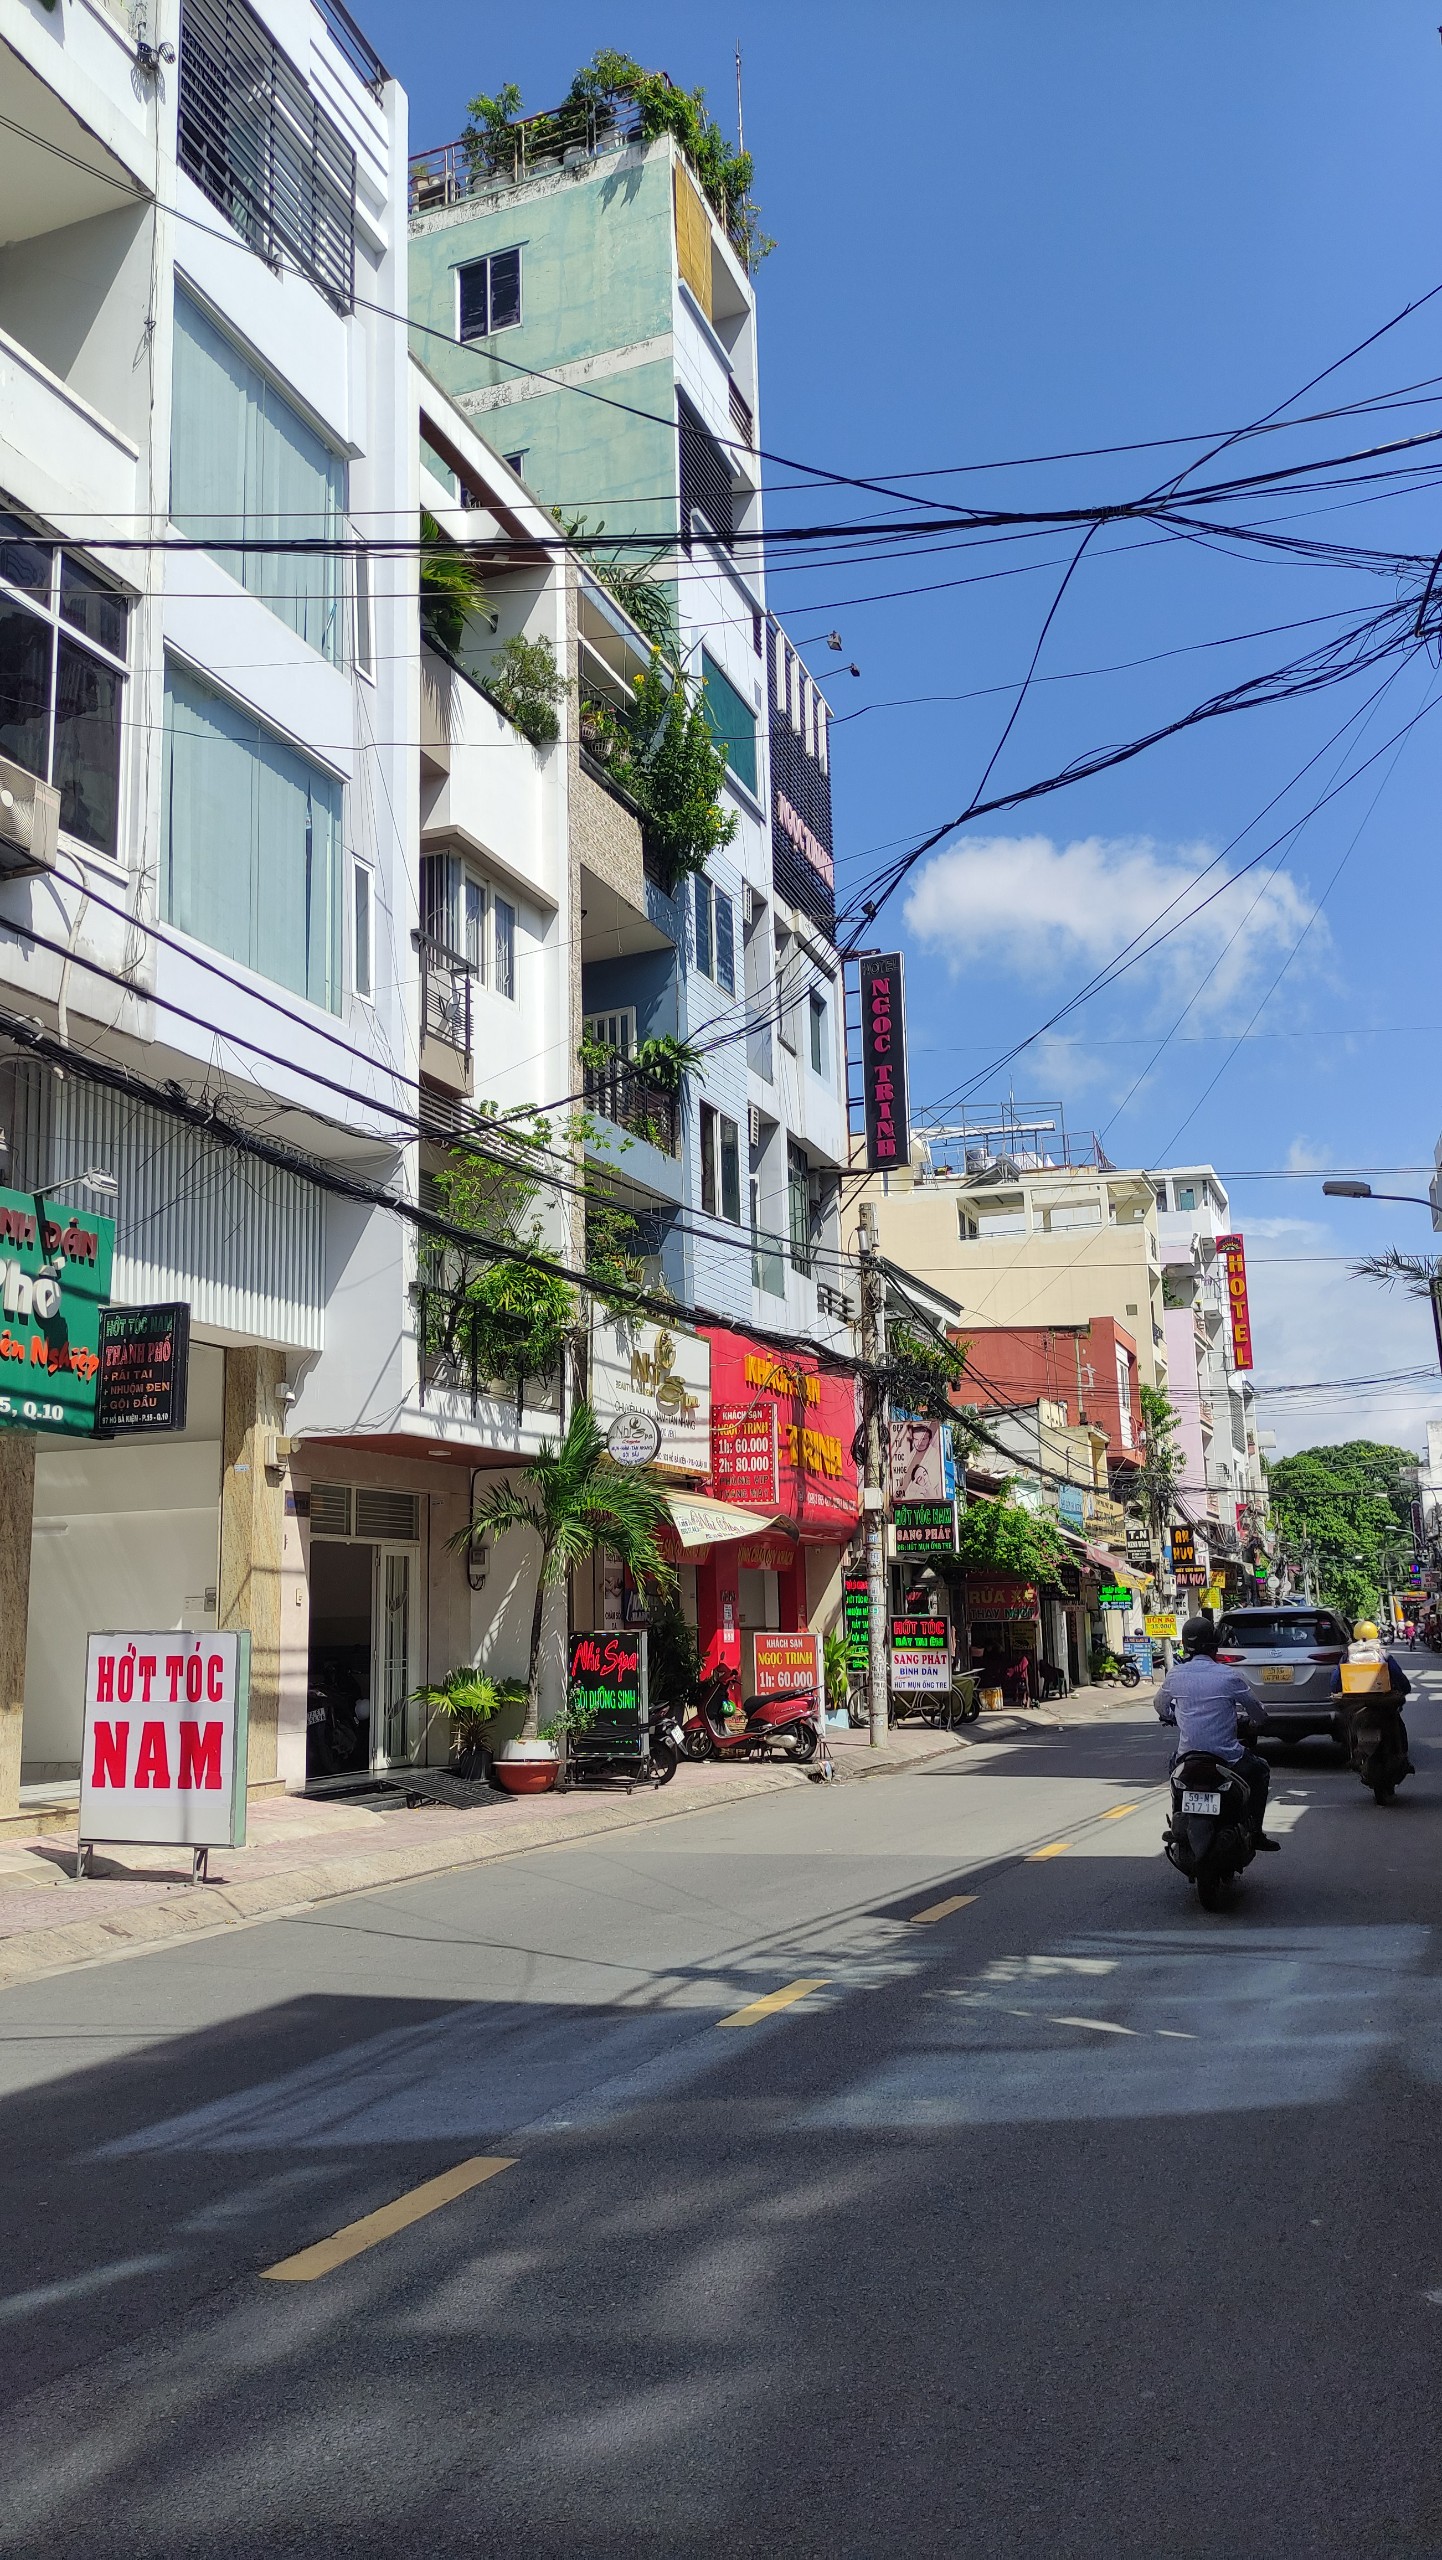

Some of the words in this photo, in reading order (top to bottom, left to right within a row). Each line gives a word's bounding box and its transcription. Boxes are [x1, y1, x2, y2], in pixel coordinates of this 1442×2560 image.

[862, 958, 899, 976] HOTEL
[1228, 1254, 1250, 1367] HOTEL
[148, 1333, 172, 1362] PHỐ
[133, 1369, 153, 1379] TAI
[110, 1383, 144, 1395] NHUỘM
[146, 1382, 170, 1392] ĐEN
[133, 1395, 157, 1408] ĐẦU
[23, 1401, 64, 1421] Q.10
[156, 1413, 168, 1421] Q.10
[722, 1410, 746, 1420] KHÁCH
[748, 1410, 762, 1420] SẠN
[742, 1422, 768, 1434] TRINH
[718, 1440, 732, 1454] 1h:
[736, 1437, 768, 1453] 60.000
[785, 1423, 843, 1477] TRINH
[718, 1458, 732, 1472] 2h:
[736, 1456, 768, 1472] 80.000
[754, 1475, 768, 1484] VIP
[896, 1490, 906, 1498] SPA
[896, 1529, 922, 1541] SANG
[924, 1525, 951, 1540] PHÁT
[1172, 1546, 1193, 1560] HUY
[1177, 1573, 1187, 1584] AN
[970, 1608, 1000, 1619] THAY
[920, 1619, 944, 1634] TÓC
[766, 1637, 788, 1648] KHÁCH
[790, 1639, 803, 1649] SẠN
[572, 1640, 600, 1676] Nhi
[600, 1640, 638, 1682] Spa
[758, 1652, 782, 1668] NGỌC
[785, 1652, 812, 1664] TRINH
[894, 1654, 919, 1664] SANG
[922, 1652, 946, 1664] PHÁT
[97, 1643, 156, 1702] HỚT
[166, 1642, 224, 1702] TÓC
[900, 1666, 918, 1675] BÌNH
[922, 1666, 938, 1675] DÂN
[760, 1672, 774, 1687] 1h:
[778, 1671, 813, 1688] 60.000
[894, 1680, 906, 1688] HÚT
[908, 1682, 920, 1690] MỤN
[618, 1690, 636, 1709] SINH
[92, 1721, 224, 1790] NAM
[1188, 1793, 1214, 1802] 59-N1
